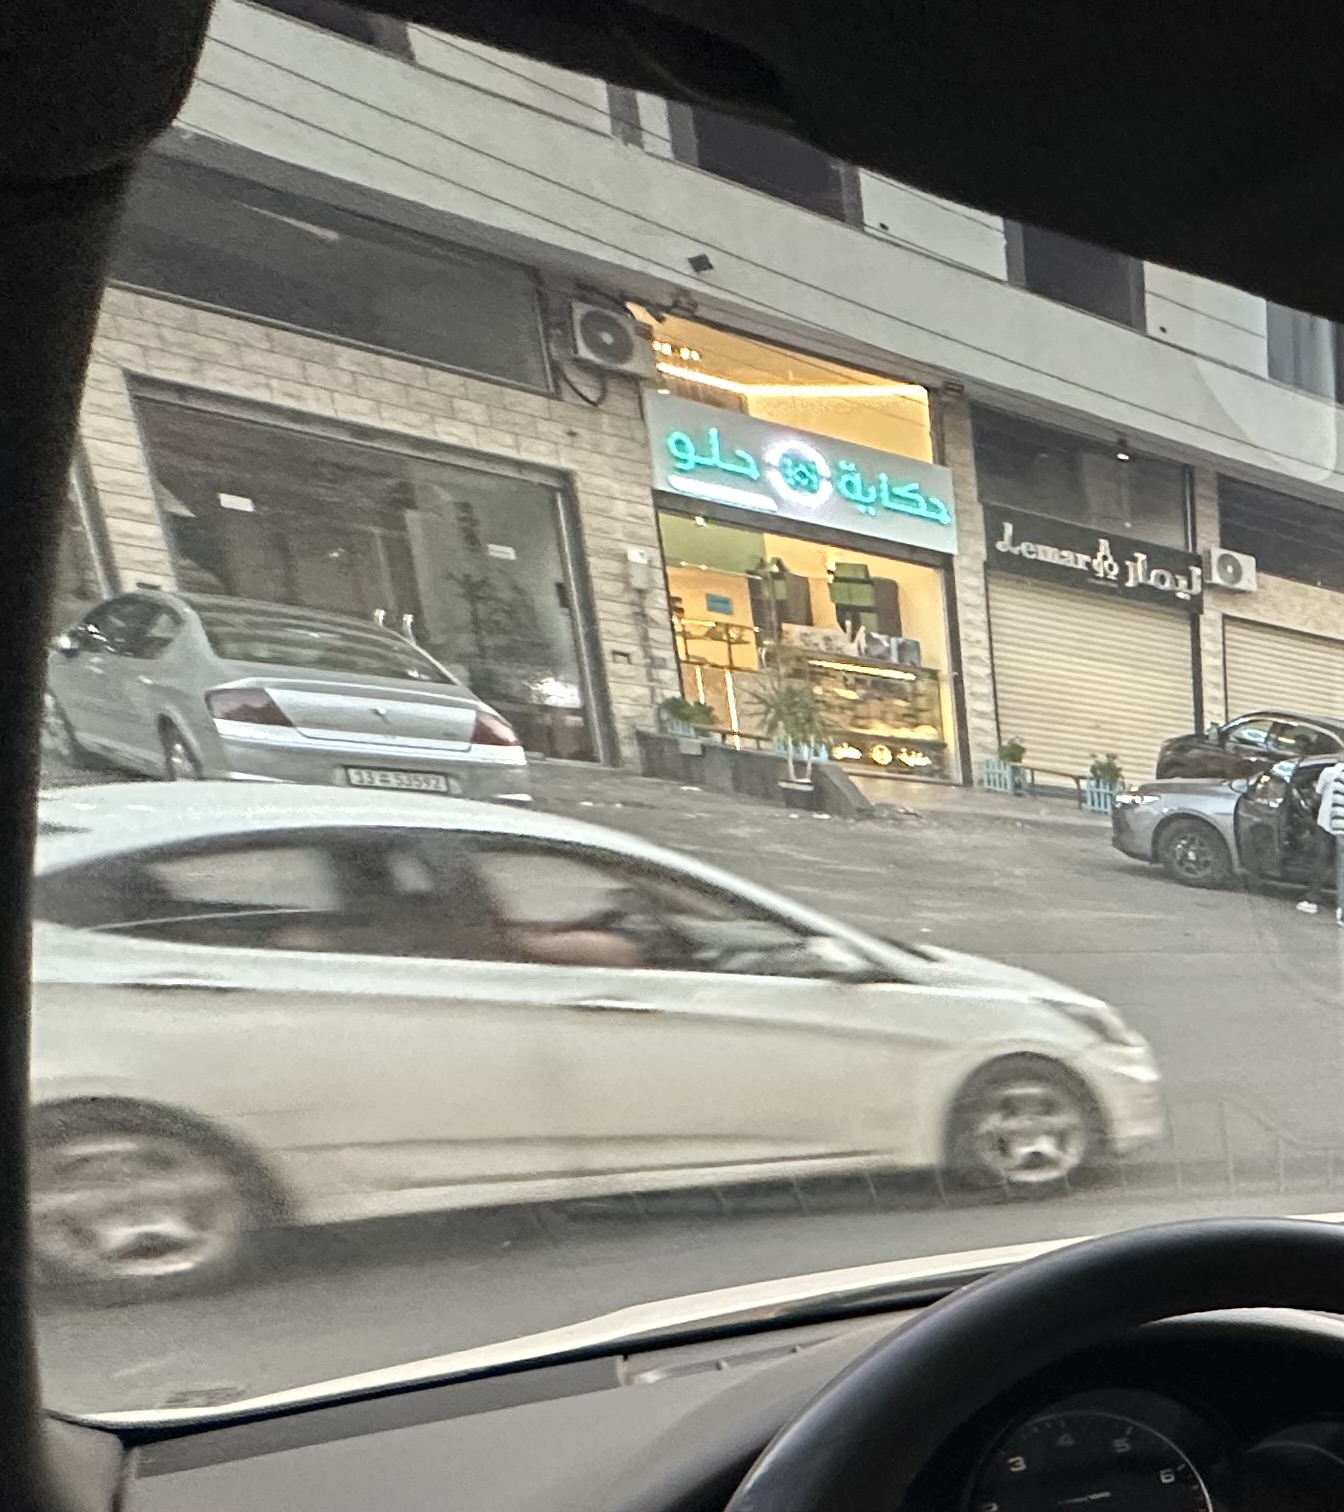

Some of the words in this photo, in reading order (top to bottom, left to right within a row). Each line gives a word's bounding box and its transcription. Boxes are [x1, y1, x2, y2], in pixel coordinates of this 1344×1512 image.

[666, 427, 760, 480] حلو
[837, 460, 951, 525] حكاية
[995, 522, 1091, 572] Lemar
[1124, 552, 1201, 600] ليمار
[1007, 1456, 1027, 1472] 3
[1159, 1467, 1175, 1484] 6
